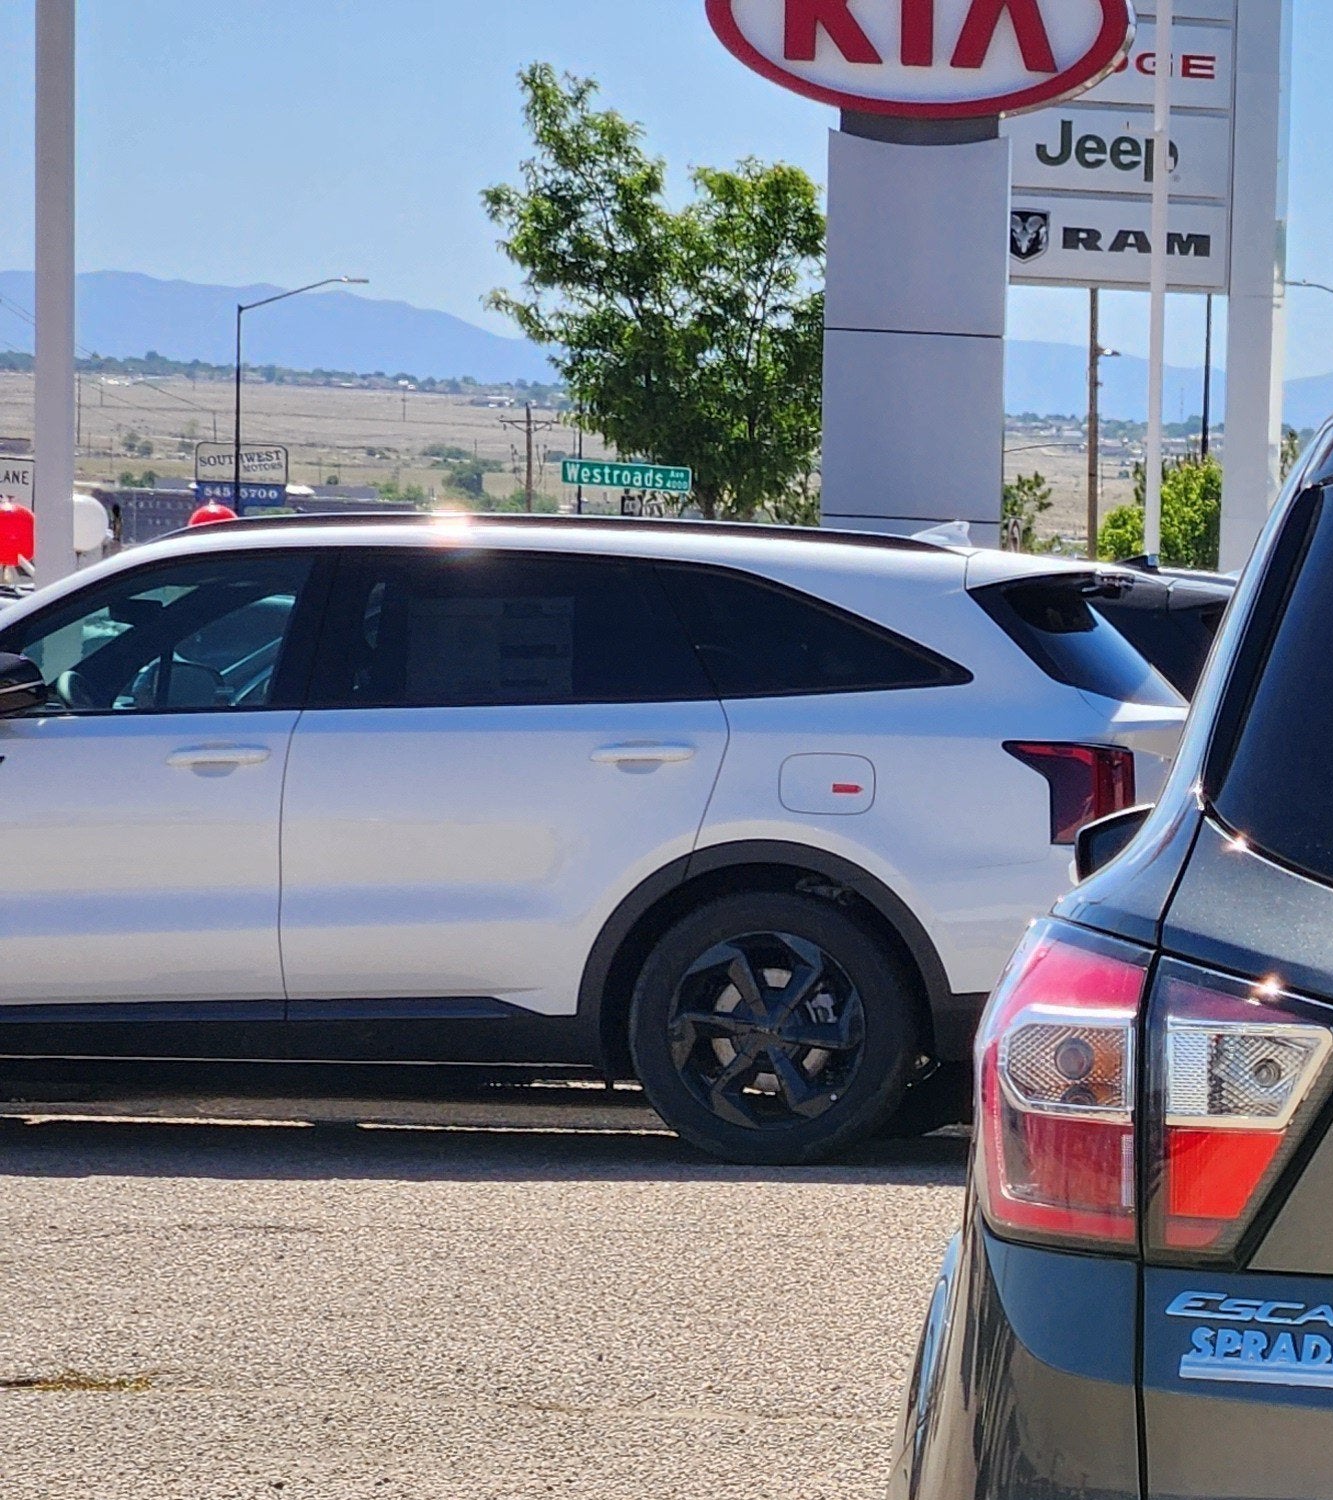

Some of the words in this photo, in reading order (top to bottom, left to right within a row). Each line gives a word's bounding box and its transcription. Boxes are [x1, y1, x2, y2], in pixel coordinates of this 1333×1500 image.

[1035, 119, 1179, 182] Jeep
[1062, 226, 1211, 257] RAM
[199, 450, 282, 467] SOUTWEST
[243, 462, 283, 473] MOTORS
[0, 470, 29, 485] ANE
[566, 462, 664, 487] Westroads
